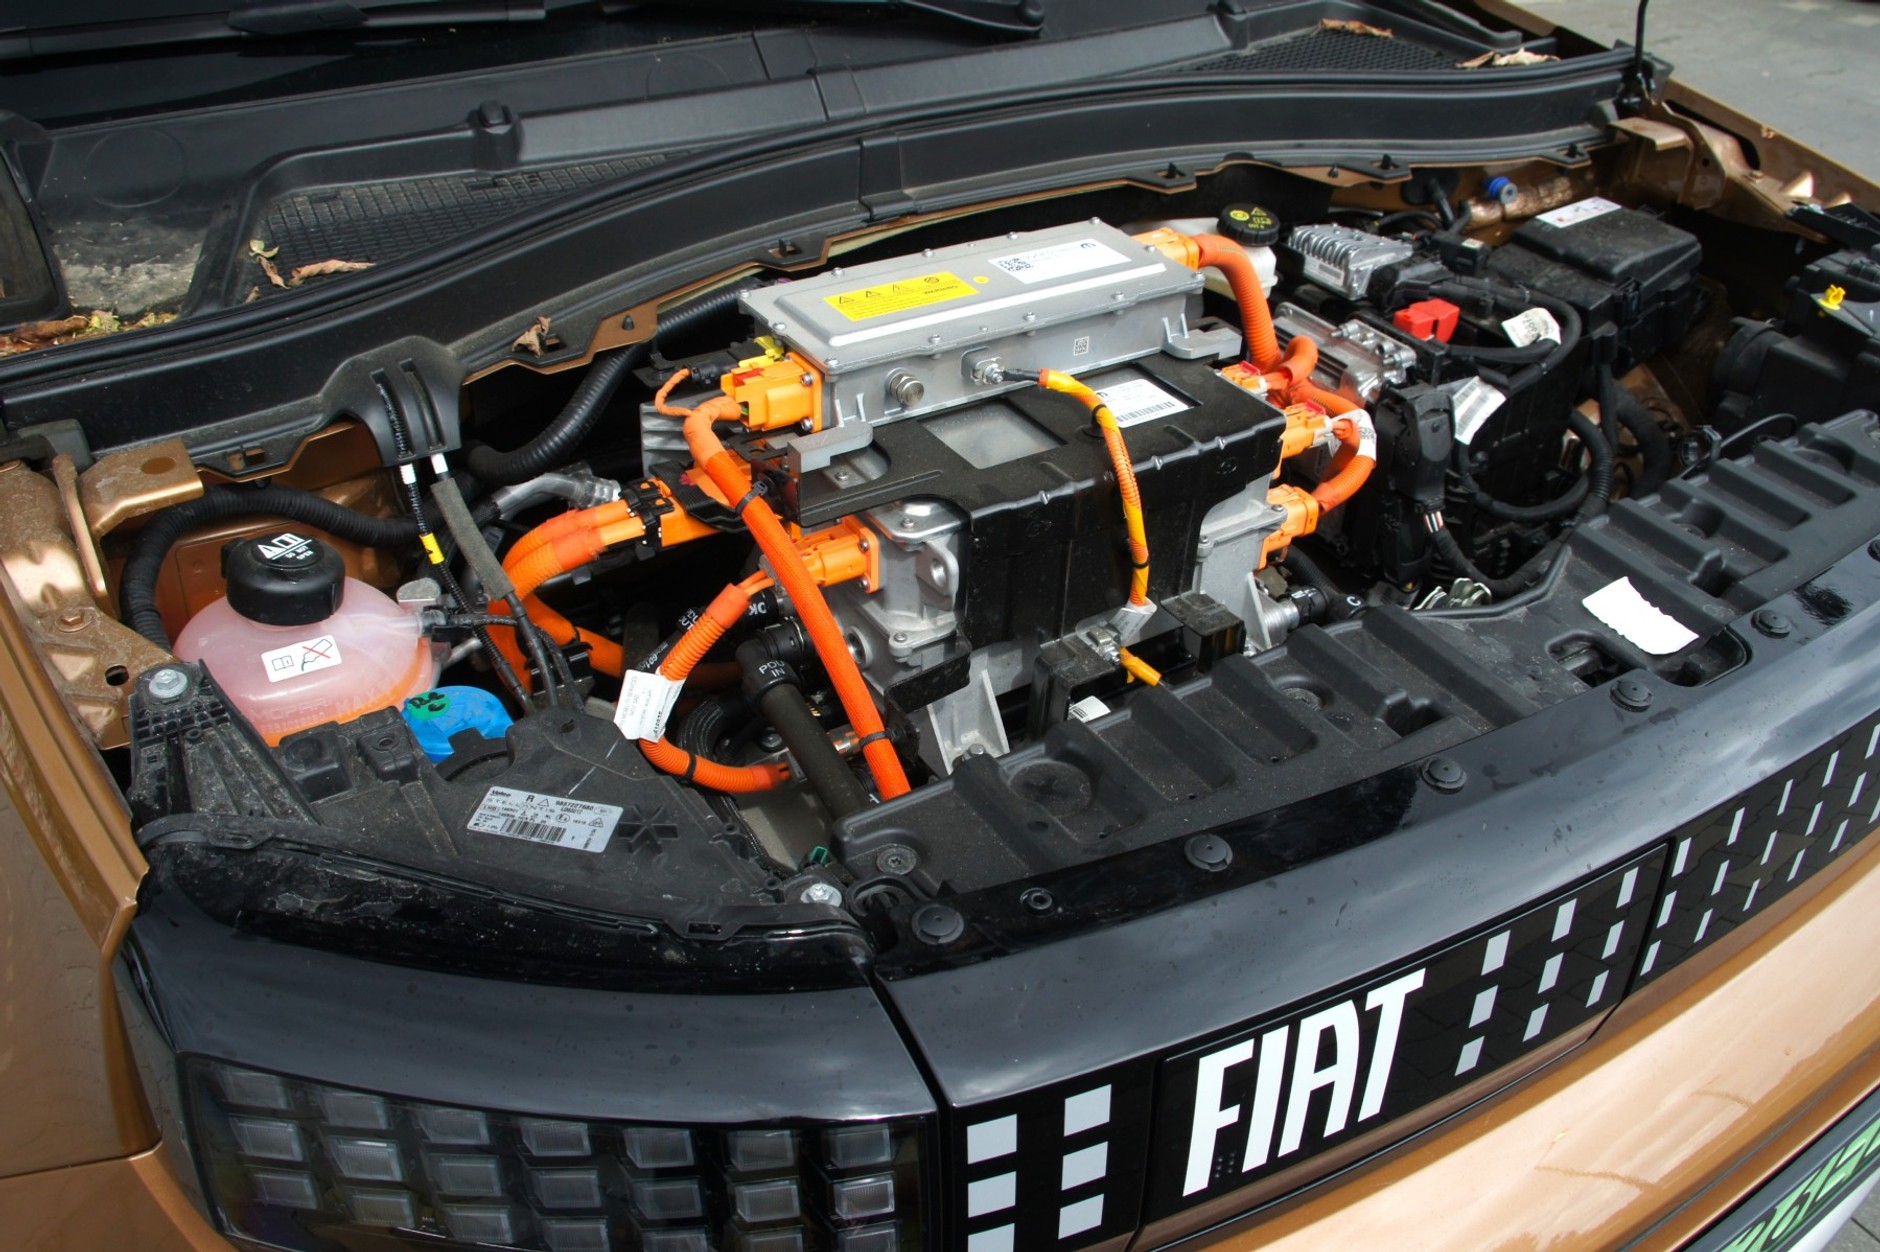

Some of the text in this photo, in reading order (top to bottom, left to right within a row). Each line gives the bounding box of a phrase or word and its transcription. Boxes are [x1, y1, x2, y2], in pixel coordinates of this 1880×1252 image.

[758, 660, 785, 675] PDU
[770, 668, 786, 678] IN
[486, 797, 556, 814] STELLANTIS
[525, 794, 535, 803] R
[1182, 967, 1426, 1197] FIAT
